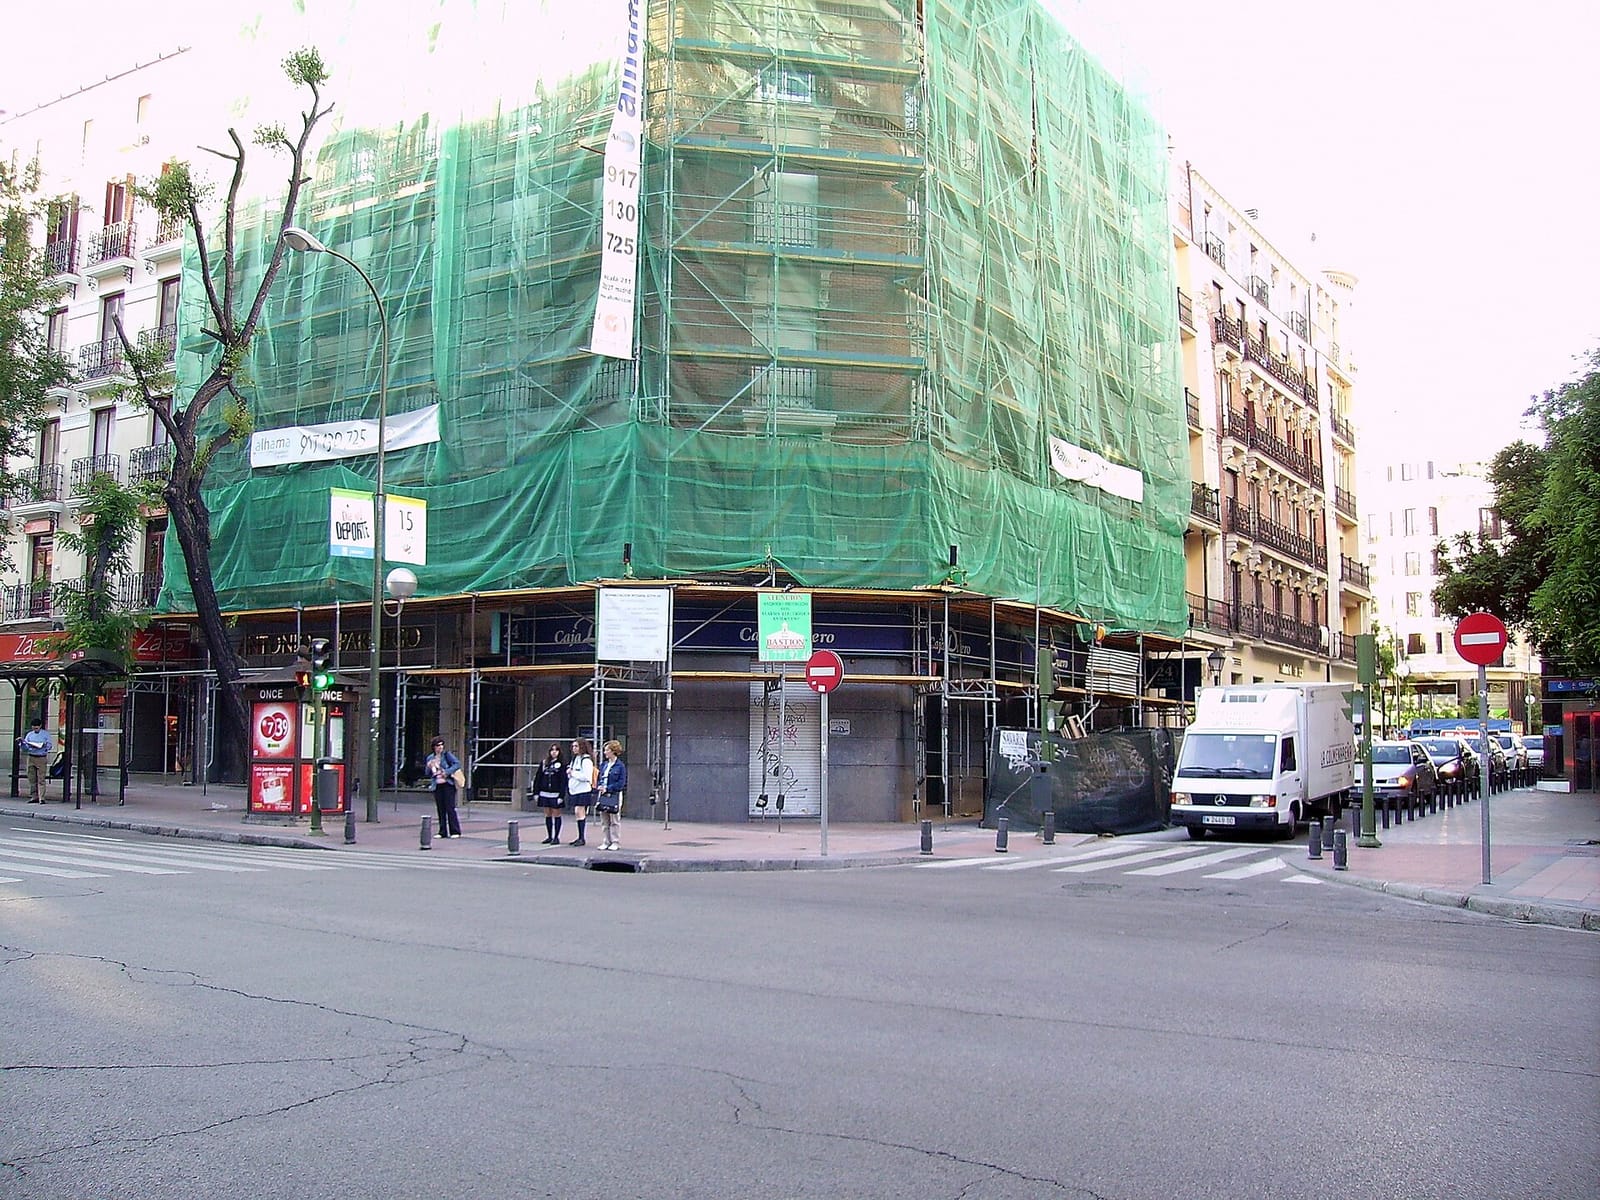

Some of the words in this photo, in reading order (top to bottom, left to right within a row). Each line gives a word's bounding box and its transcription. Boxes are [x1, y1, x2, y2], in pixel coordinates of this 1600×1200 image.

[618, 0, 639, 118] alham
[608, 165, 637, 189] 917
[608, 199, 635, 222] 130
[606, 231, 634, 256] 725
[255, 437, 290, 452] alhama
[300, 434, 320, 455] 917
[346, 428, 366, 445] 725
[335, 520, 370, 542] DEPORTE
[399, 509, 414, 531] 15
[555, 629, 582, 648] Caja
[259, 688, 284, 699] ONCE
[267, 722, 274, 734] 7
[275, 717, 289, 737] 39
